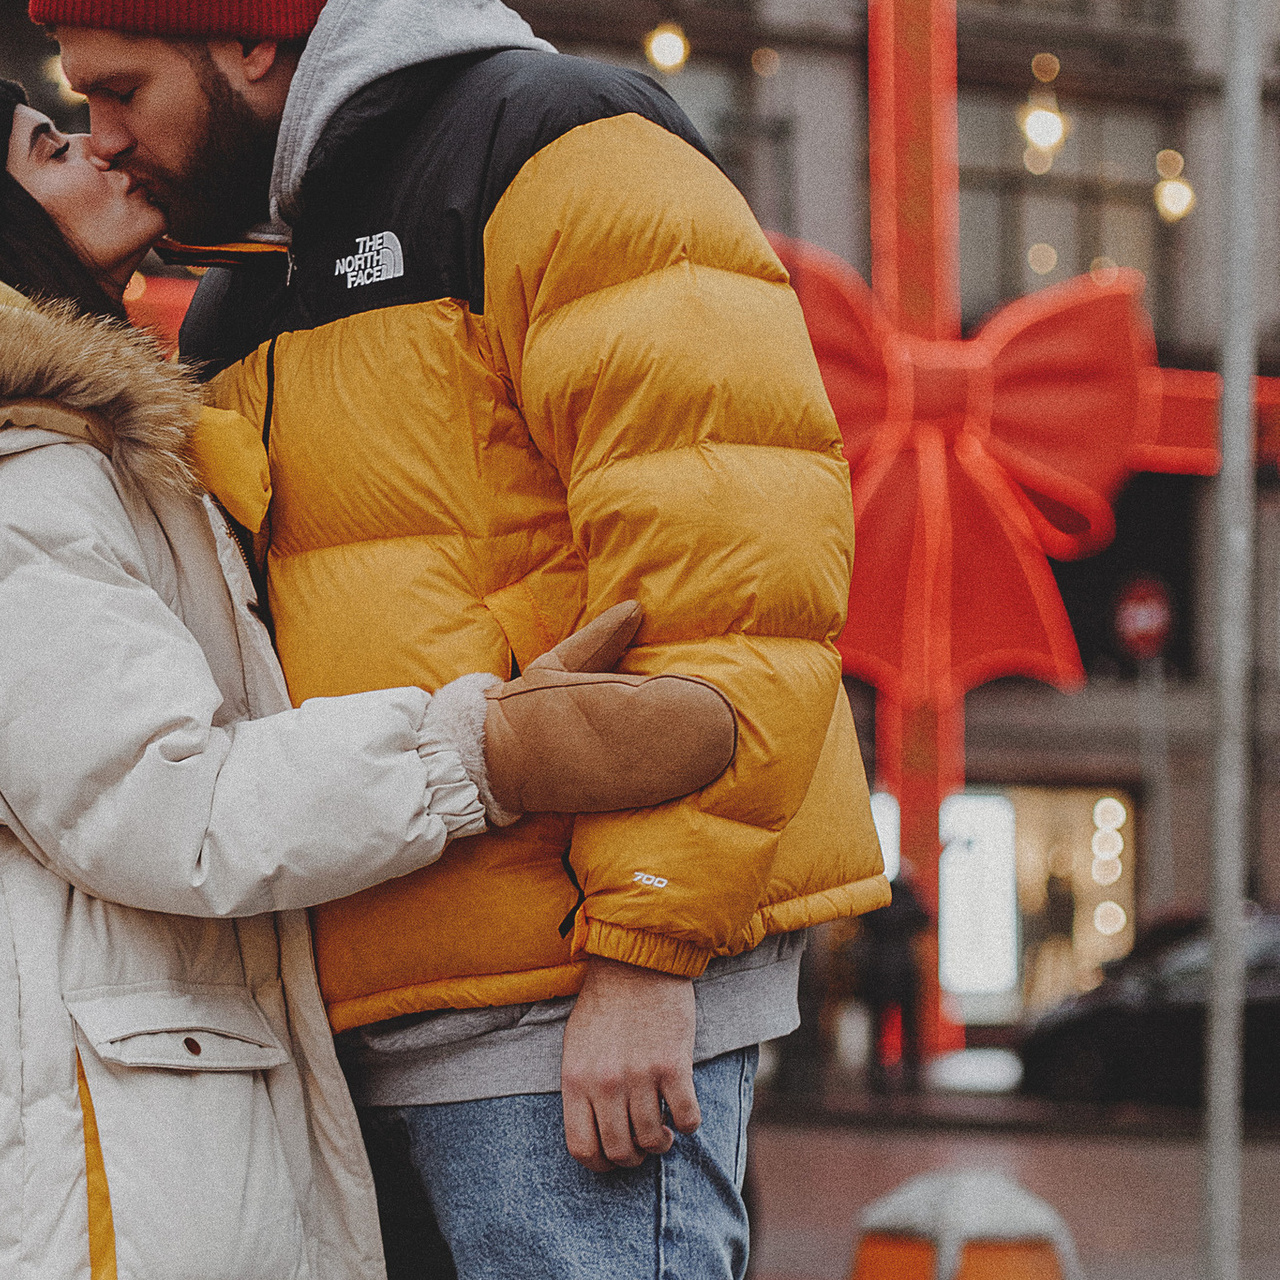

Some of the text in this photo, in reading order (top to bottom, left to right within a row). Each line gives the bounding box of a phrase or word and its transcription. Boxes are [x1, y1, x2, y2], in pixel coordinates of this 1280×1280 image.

[355, 233, 383, 254] THE
[334, 251, 382, 276] NORTH
[347, 266, 382, 289] FACE
[632, 871, 668, 888] 700
